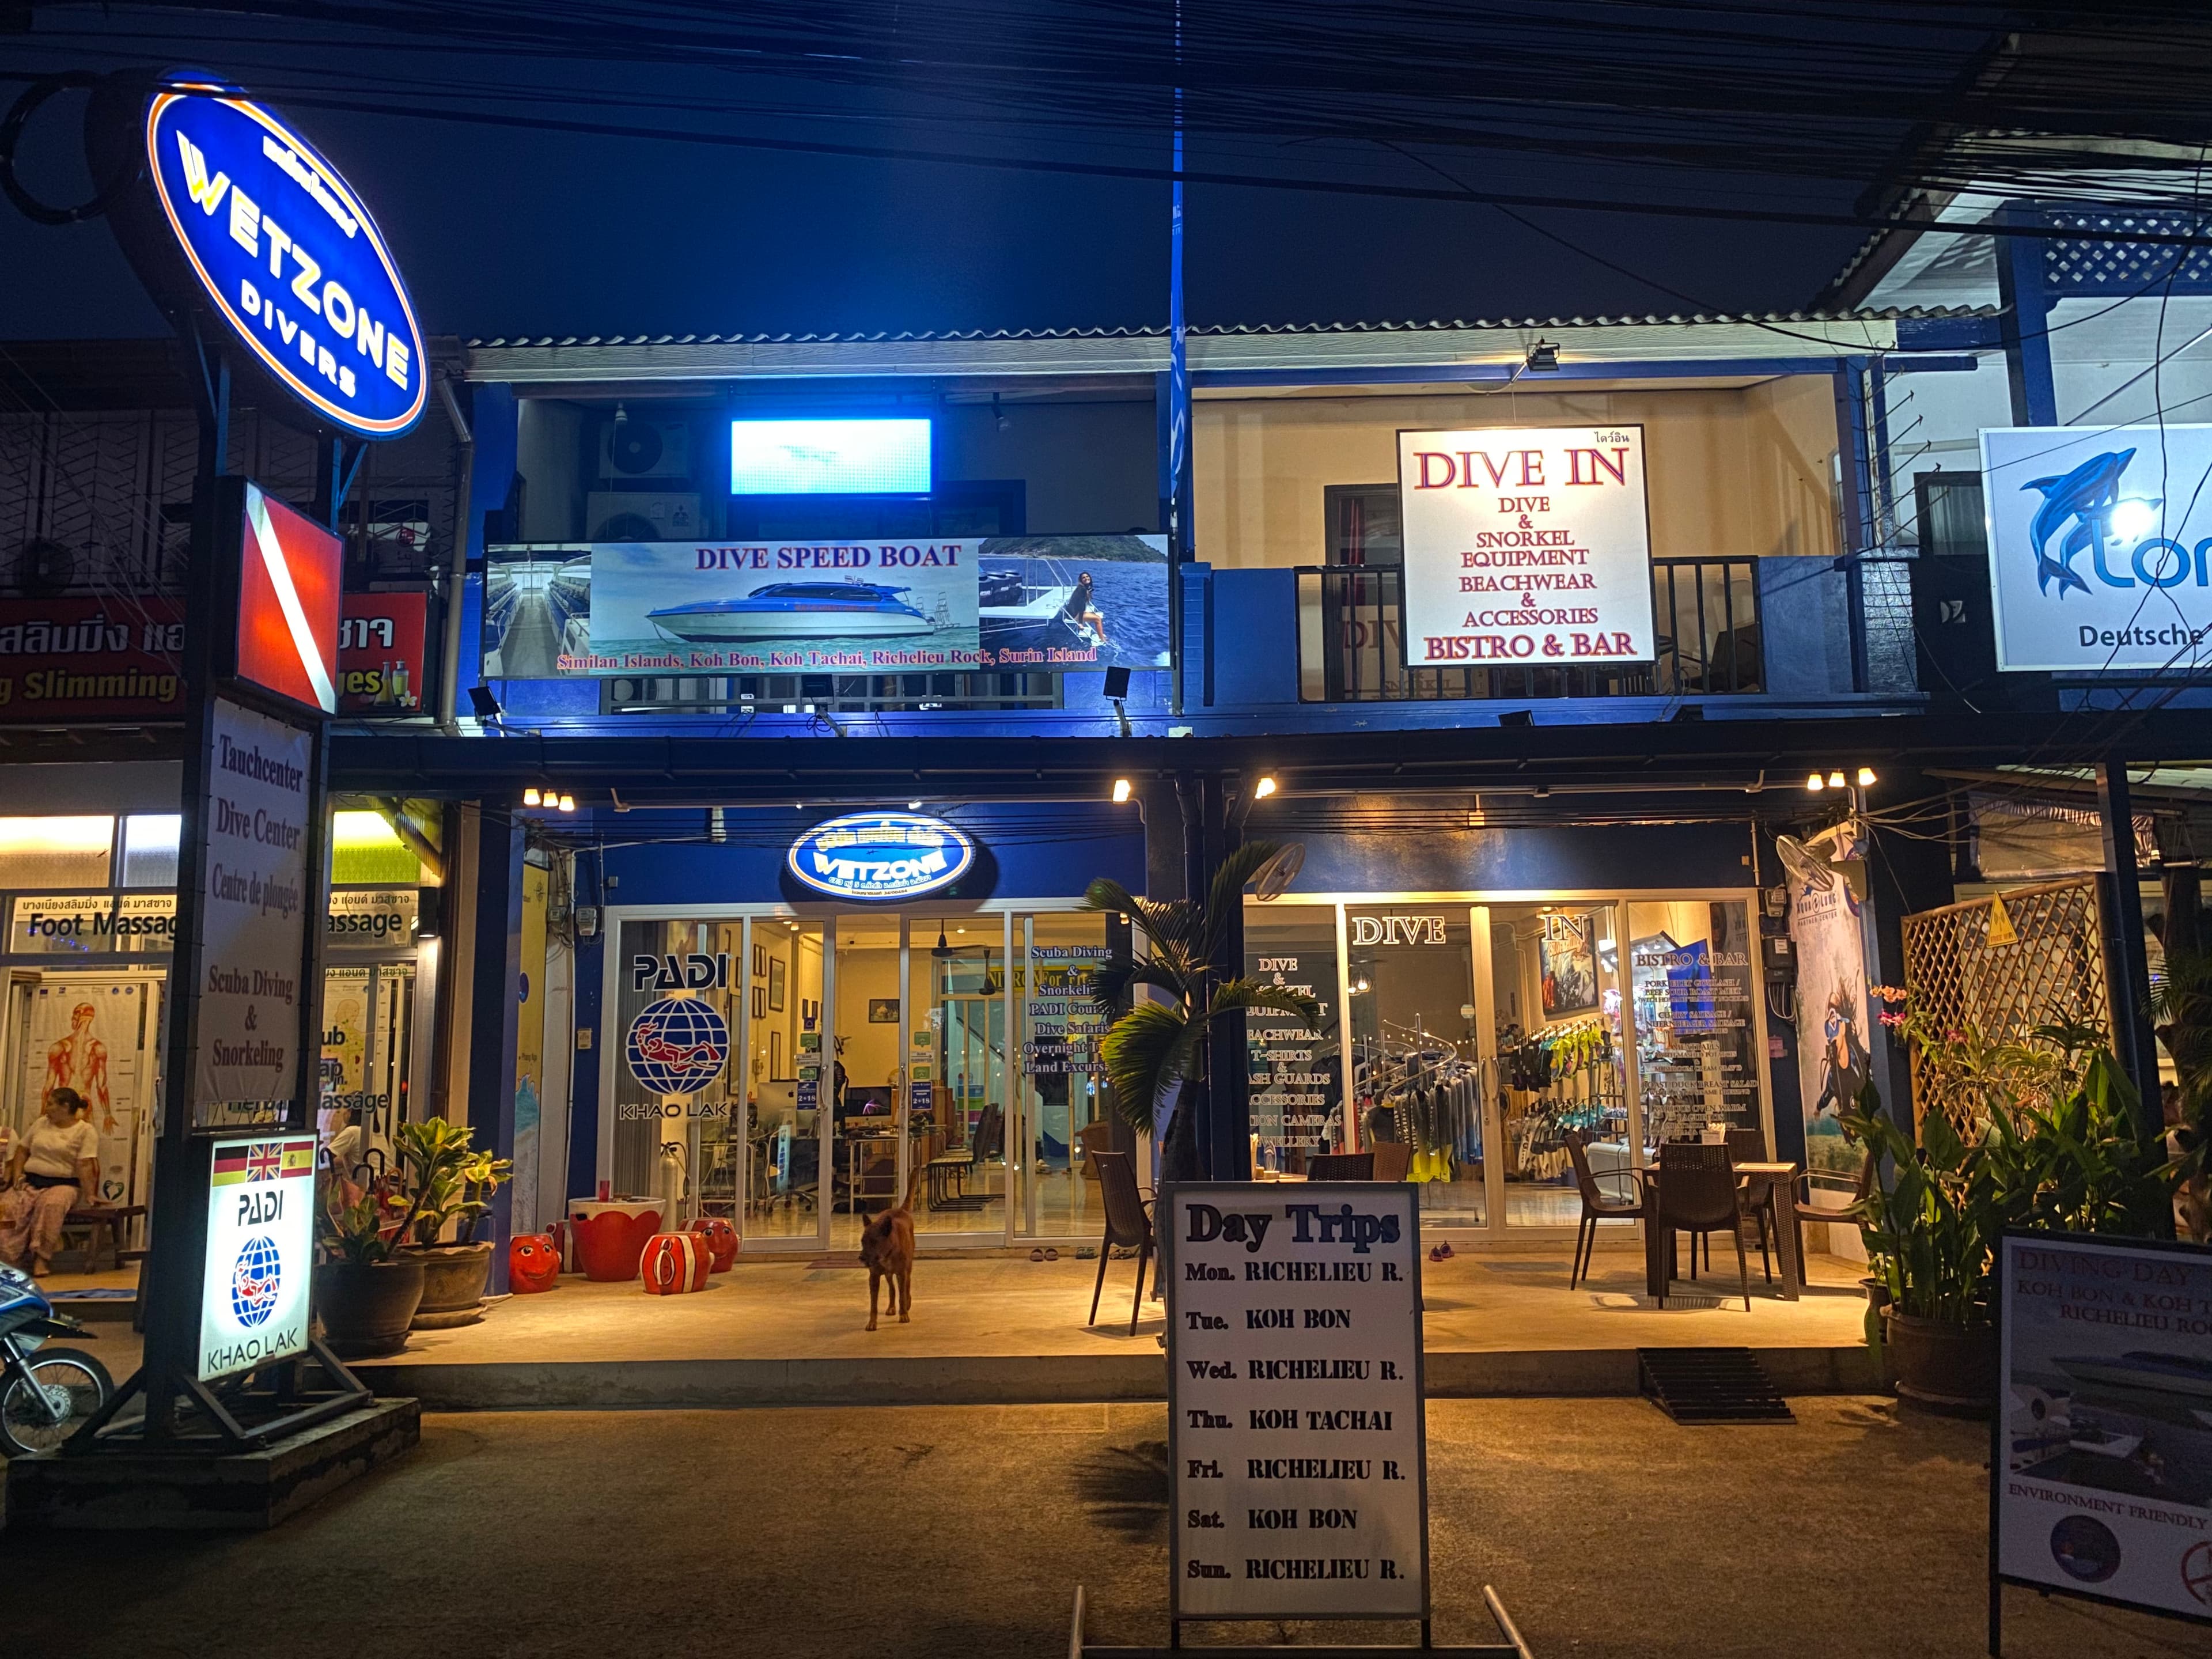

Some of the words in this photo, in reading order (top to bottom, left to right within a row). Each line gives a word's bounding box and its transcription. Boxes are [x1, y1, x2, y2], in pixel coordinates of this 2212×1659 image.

[176, 130, 409, 391] WETZONE
[241, 279, 355, 398] DIVERS
[1594, 431, 1630, 443] ไดว์อิน
[1413, 450, 1546, 490] DIVE
[1564, 448, 1630, 486] IN
[1498, 497, 1551, 513] DIVE
[1518, 514, 1533, 529] &
[1476, 531, 1575, 548] SNORKEL
[695, 546, 769, 570] DIVE
[777, 545, 872, 570] SPEED
[878, 544, 962, 568] BOAT
[1461, 549, 1590, 568] EQUIPMENT
[1459, 574, 1597, 592] BEACHWEAR
[1521, 593, 1536, 608] &
[1462, 608, 1599, 628] ACCESSORIES
[1343, 620, 1399, 649] DIV
[2079, 623, 2204, 647] Deutsche
[1423, 635, 1535, 660] BISTRO
[1541, 634, 1565, 658] &
[1570, 631, 1638, 657] BAR
[556, 653, 618, 671] Similan
[623, 653, 684, 670] Islands,
[691, 652, 723, 668] Koh
[728, 652, 765, 669] Bon,
[770, 652, 803, 667] Koh
[808, 650, 866, 667] Tachai,
[873, 649, 945, 665] Richelieu
[950, 648, 995, 666] Rock,
[999, 647, 1043, 663] Surin
[1047, 646, 1097, 662] Island
[23, 668, 177, 703] Slimming
[219, 734, 303, 794] Tauchcenter
[217, 798, 251, 840] Dive
[254, 809, 300, 852] Center
[813, 850, 948, 880] WETZONE
[213, 863, 247, 904] Centre
[249, 870, 262, 905] de
[262, 876, 299, 918] plongée
[29, 913, 84, 937] Foot
[327, 914, 403, 938] assage
[1352, 916, 1446, 945] DIVE
[1540, 914, 1588, 943] IN
[1031, 946, 1069, 959] Scuba
[1071, 946, 1113, 960] Diving
[1635, 953, 1692, 967] BISTRO
[1698, 953, 1710, 966] &
[1713, 952, 1749, 966] BAR
[634, 953, 729, 992] PADI
[1066, 964, 1079, 976] &
[1258, 957, 1298, 971] DIVE
[208, 965, 249, 996] Scuba
[252, 969, 293, 1005] Diving
[1272, 972, 1285, 985] &
[1039, 984, 1094, 997] Snorkeli
[245, 1005, 257, 1031] &
[1029, 1002, 1065, 1016] PADI
[1658, 1011, 1687, 1019] CURRY
[1035, 1022, 1065, 1035] Dive
[1067, 1021, 1111, 1035] Safaris
[1247, 1028, 1324, 1041] EACHWEAR
[212, 1039, 285, 1073] Snorkeling
[1023, 1040, 1086, 1056] Overnight
[1251, 1050, 1313, 1061] T-SHIRTS
[1025, 1060, 1058, 1074] Land
[1277, 1062, 1288, 1073] &
[1248, 1073, 1271, 1085] ASH
[1274, 1073, 1331, 1085] GUARDS
[321, 1093, 390, 1113] assage
[1249, 1093, 1326, 1106] CCESSORIES
[620, 1104, 681, 1120] KHAO
[686, 1101, 729, 1117] LAK
[1281, 1114, 1342, 1127] CAMERAS
[1257, 1135, 1321, 1147] EWELLERY
[237, 1190, 283, 1226] PADI
[1185, 1204, 1272, 1252] Day
[1285, 1203, 1400, 1253] Trips
[1185, 1263, 1235, 1281] Mon.
[1244, 1262, 1372, 1282] RICHELIEU
[1381, 1262, 1403, 1282] R.
[2018, 1249, 2121, 1278] DIVING
[2133, 1262, 2194, 1286] DAY
[2017, 1279, 2062, 1298] KOH
[2071, 1285, 2113, 1304] BON
[2122, 1291, 2135, 1306] &
[2142, 1293, 2192, 1313] KOH
[1185, 1312, 1229, 1330] Tue.
[1245, 1309, 1294, 1329] KOH
[1304, 1309, 1351, 1329] BON
[2060, 1304, 2169, 1330] RICHELIEU
[207, 1338, 261, 1374] KHAO
[265, 1327, 298, 1358] LAK
[1187, 1361, 1237, 1379] Wed.
[1248, 1359, 1370, 1380] RICHELIEU
[1380, 1361, 1403, 1380] R.
[1187, 1410, 1233, 1429] Thu.
[1249, 1409, 1298, 1429] KOH
[1306, 1410, 1392, 1430] TACHAI
[1187, 1460, 1223, 1478] Fri.
[1247, 1459, 1371, 1479] RICHELIEU
[1382, 1460, 1406, 1480] R.
[2008, 1483, 2125, 1515] ENVIRONMENT
[2129, 1505, 2209, 1530] FRIENDLY
[1187, 1509, 1225, 1528] Sat.
[1248, 1509, 1297, 1529] KOH
[1309, 1509, 1358, 1529] BON
[1187, 1559, 1231, 1579] Sun.
[1245, 1559, 1369, 1580] RICHELIEU
[1380, 1559, 1404, 1580] R.
